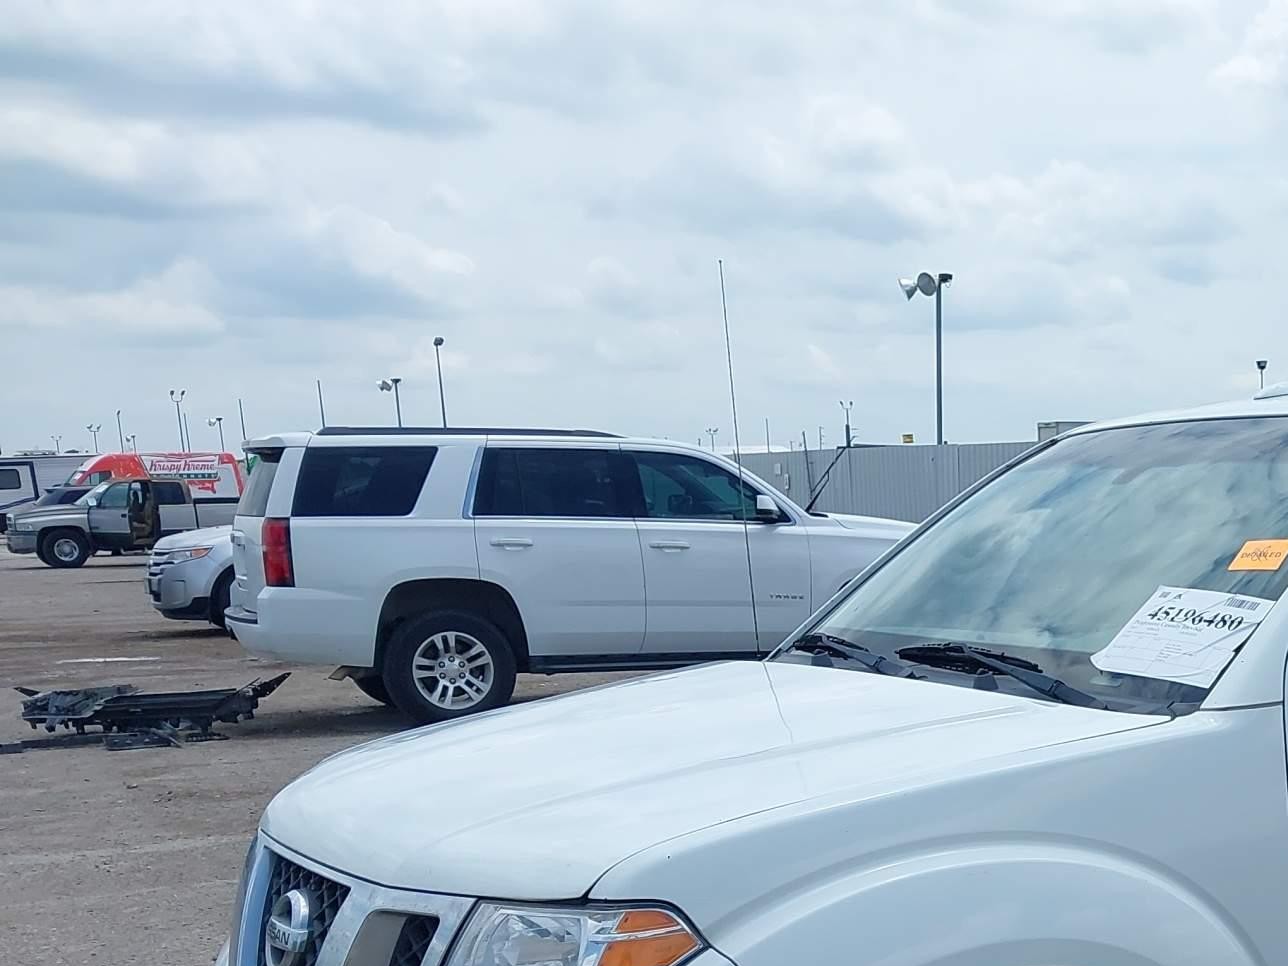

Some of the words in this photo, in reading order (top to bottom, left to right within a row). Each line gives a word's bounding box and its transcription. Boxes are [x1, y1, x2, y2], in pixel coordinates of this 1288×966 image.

[149, 460, 182, 474] Krispy
[182, 460, 215, 471] Kreme
[1148, 605, 1244, 631] 45196480
